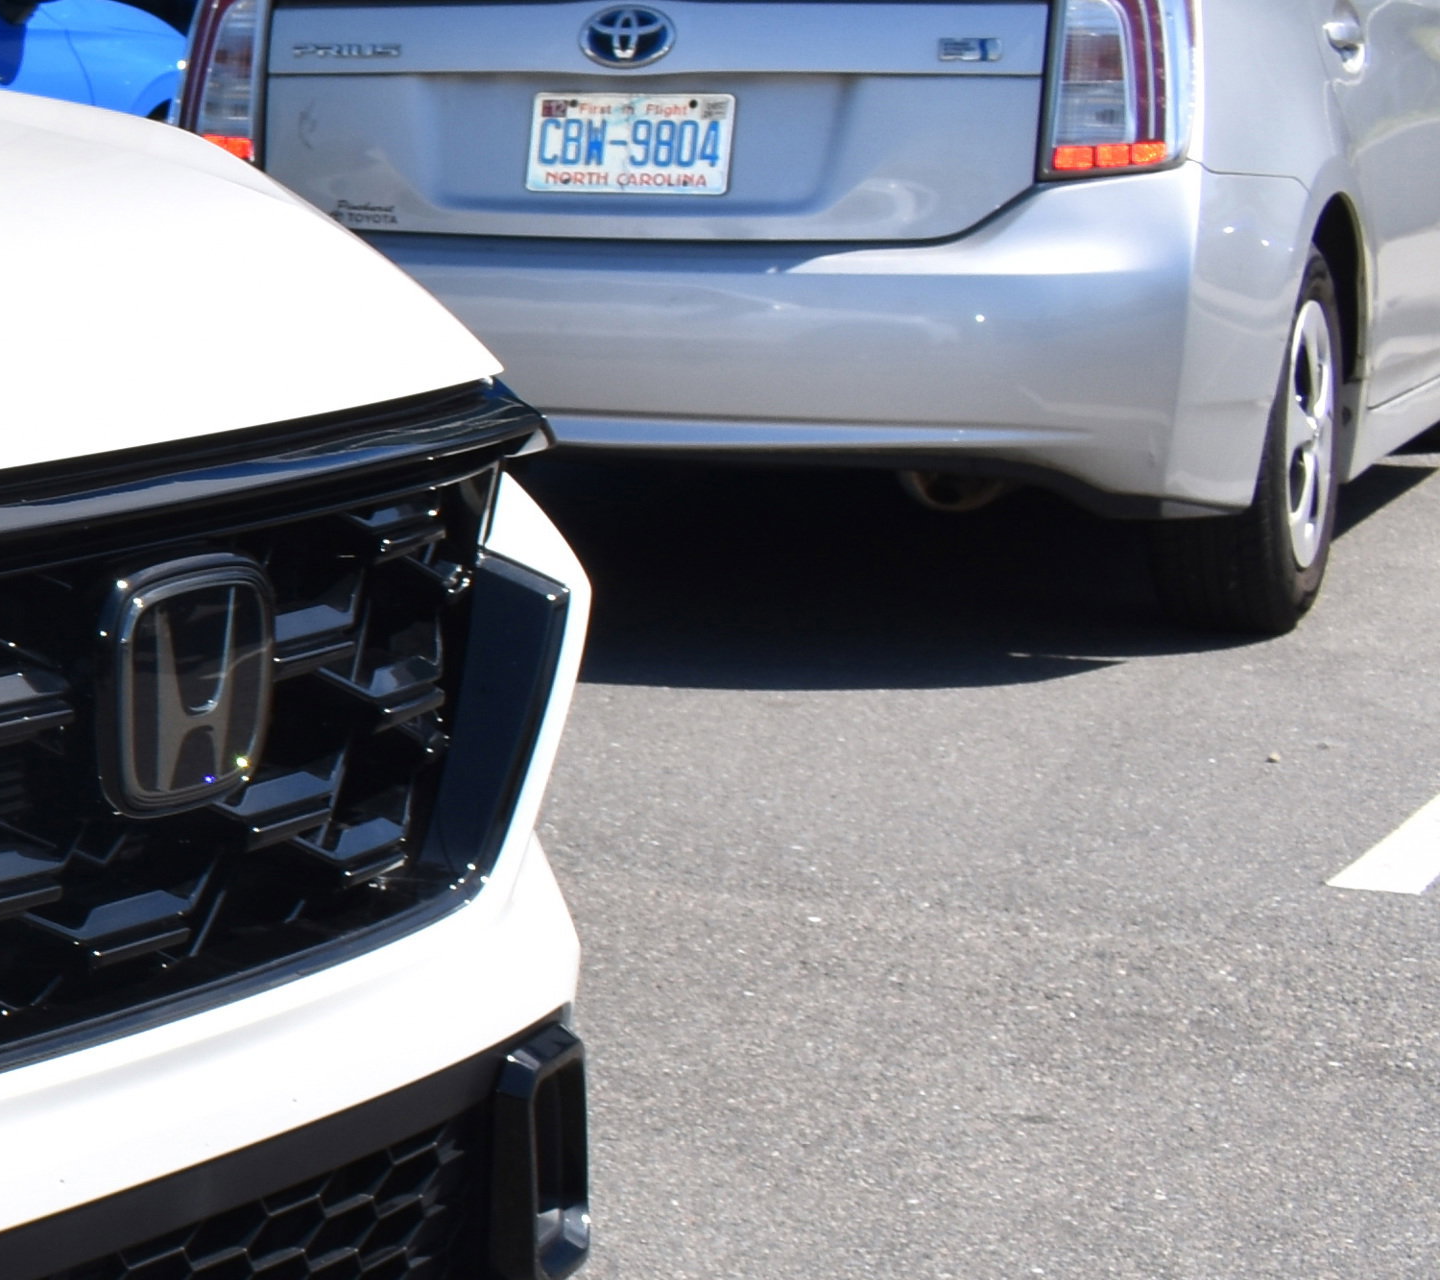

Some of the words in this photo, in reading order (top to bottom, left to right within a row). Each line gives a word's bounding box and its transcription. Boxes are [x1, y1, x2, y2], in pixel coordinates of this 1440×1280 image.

[293, 43, 401, 58] PRIUS
[579, 102, 613, 115] First
[646, 103, 688, 117] Flight
[538, 118, 720, 167] CBW-9804
[545, 172, 609, 186] NORTH
[617, 173, 708, 188] CAROLINA
[347, 211, 399, 224] TOYOTA
